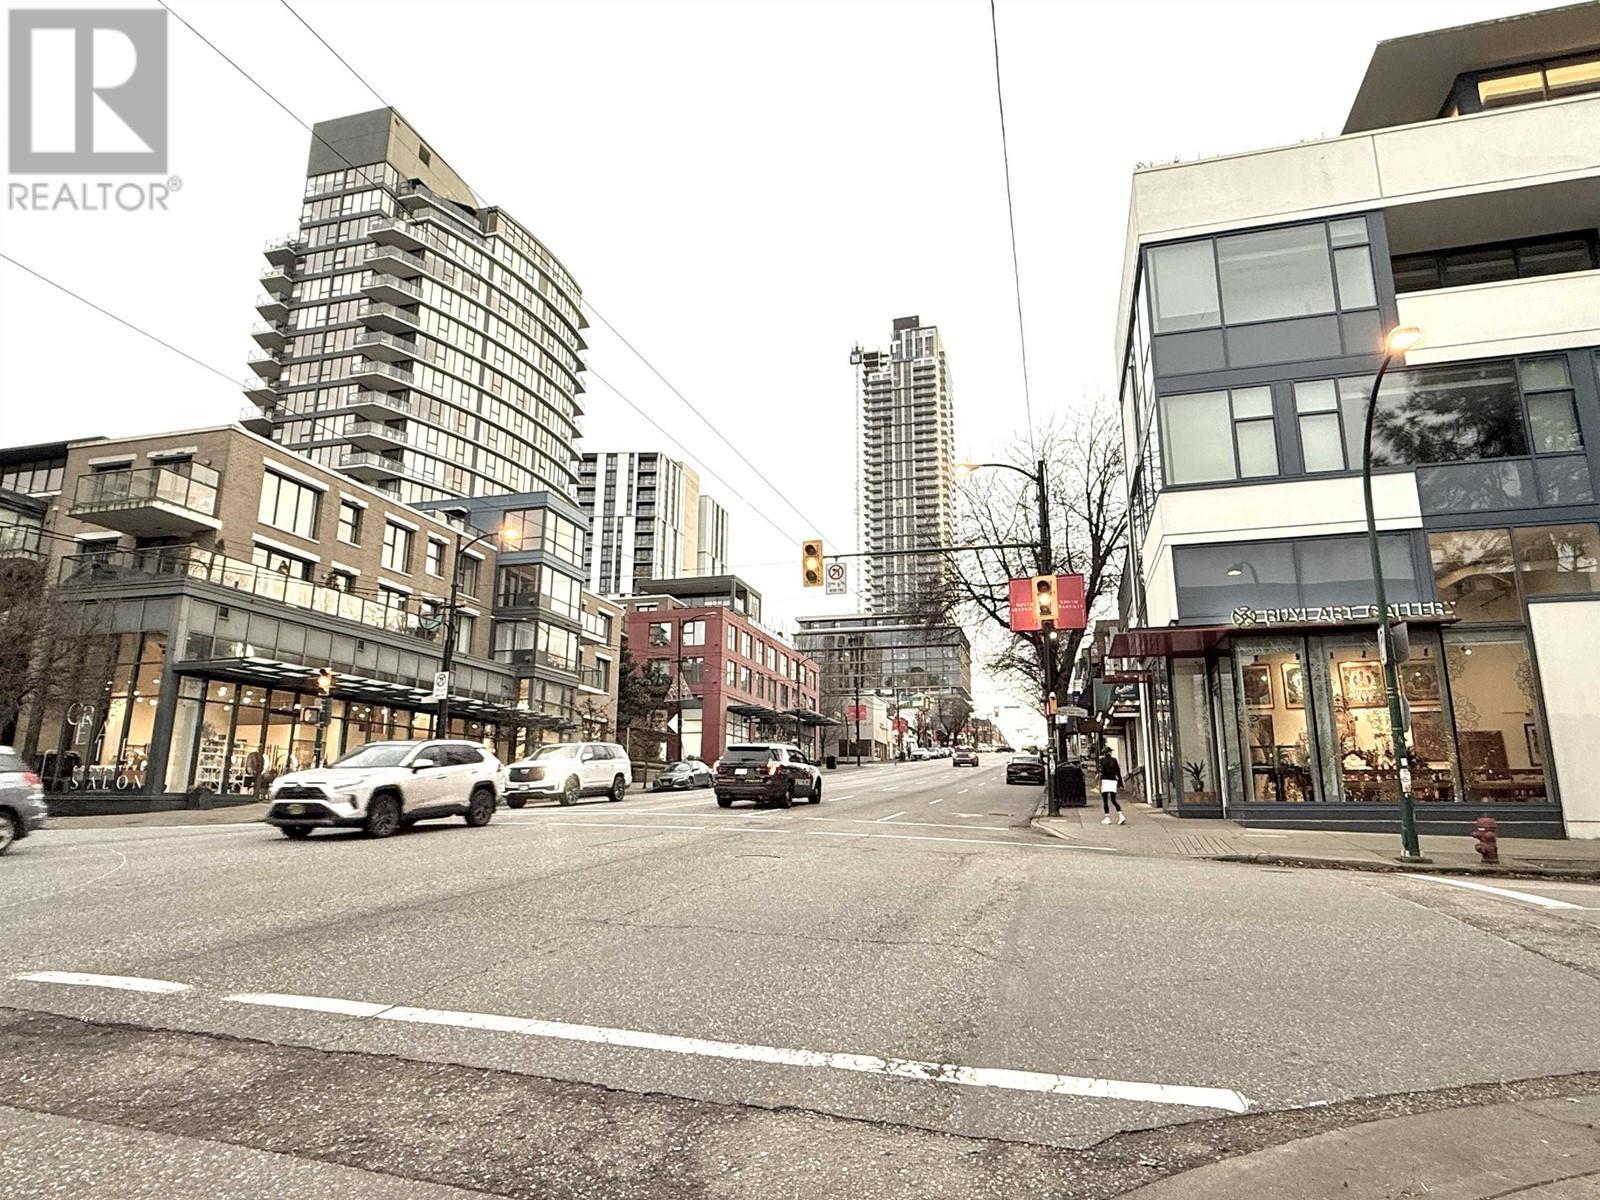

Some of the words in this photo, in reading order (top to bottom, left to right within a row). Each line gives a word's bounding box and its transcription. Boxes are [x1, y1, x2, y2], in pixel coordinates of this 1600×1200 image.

[1320, 604, 1353, 621] ART
[1368, 601, 1456, 619] GALLERY
[70, 775, 142, 790] SALON
